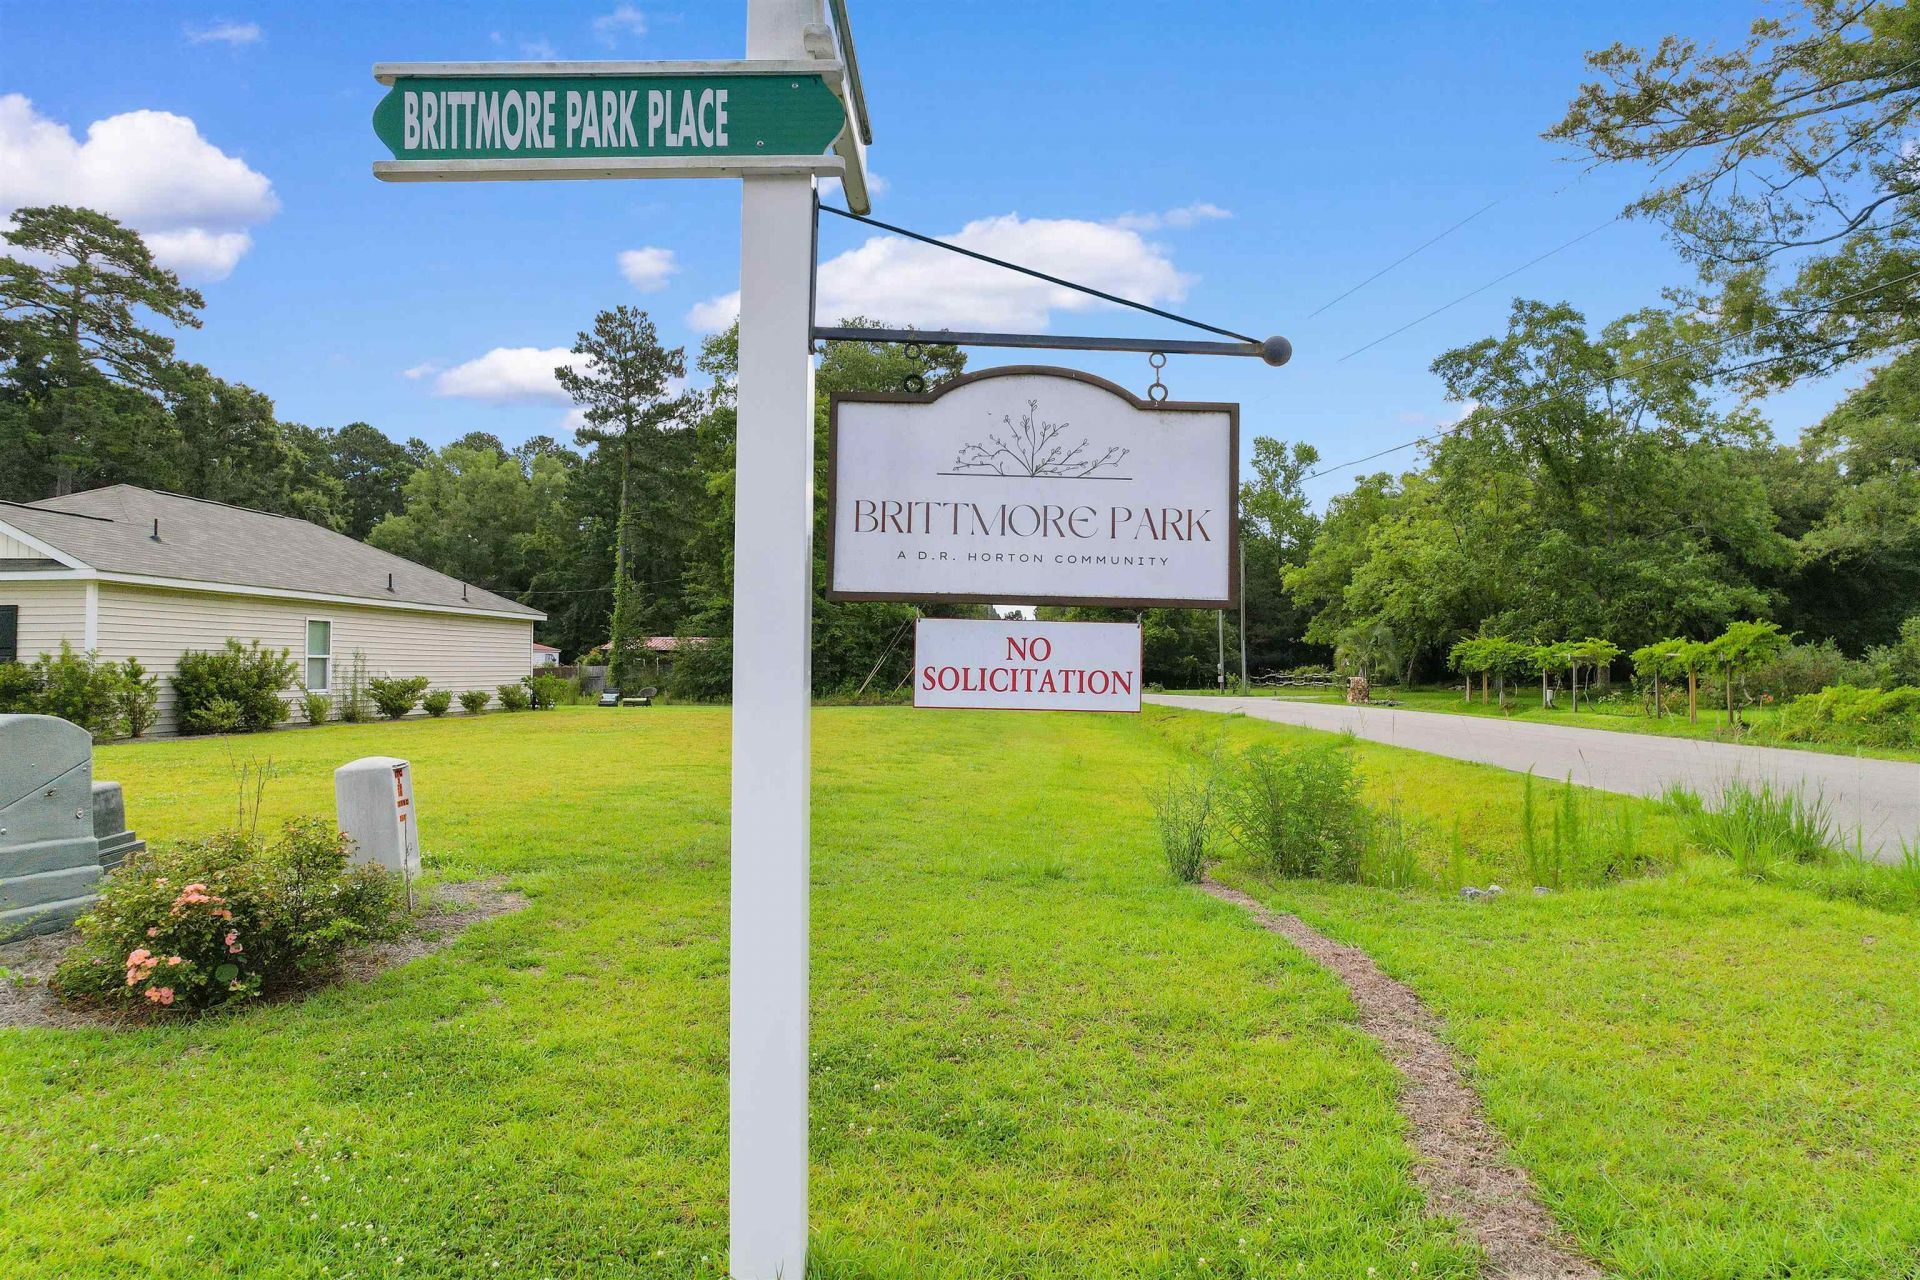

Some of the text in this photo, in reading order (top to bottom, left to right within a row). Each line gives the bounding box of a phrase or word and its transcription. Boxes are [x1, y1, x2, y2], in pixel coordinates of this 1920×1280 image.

[403, 87, 729, 151] BRITTMORE PARK PLACE
[854, 499, 1213, 542] BRITTMORE PARK
[897, 551, 1170, 566] A D.R. HORTON COMMUNITY
[1005, 636, 1052, 662] NO
[922, 666, 1134, 695] SOLICITATION
